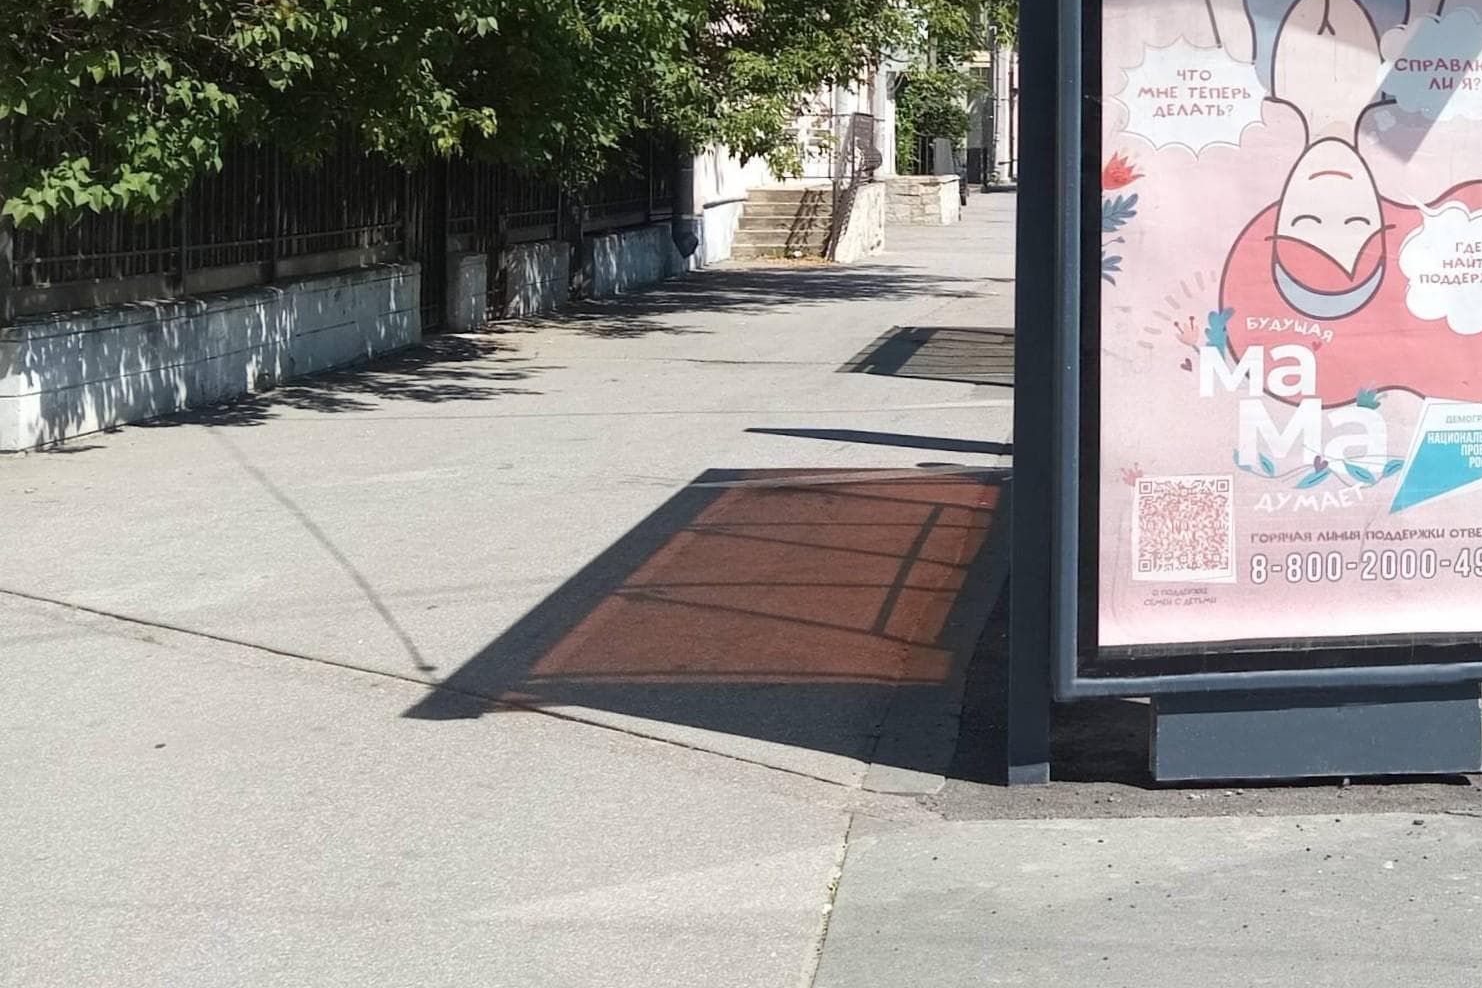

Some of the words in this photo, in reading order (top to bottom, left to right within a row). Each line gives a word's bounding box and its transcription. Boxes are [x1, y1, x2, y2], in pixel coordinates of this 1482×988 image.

[1177, 69, 1212, 81] ЧТО
[1428, 77, 1453, 90] ЛИ
[1462, 77, 1481, 90] Я?
[1137, 86, 1178, 98] МНЕ
[1188, 86, 1251, 99] ТЕПЕРЬ
[1152, 103, 1234, 118] ДЕЛАТЬ?
[1456, 242, 1482, 254] ГДЕ
[1246, 317, 1333, 342] БУДУЩАЯ
[1254, 484, 1365, 512] ДУМАЕТ
[1250, 531, 1312, 543] ГОРЯЧАЯ
[1317, 530, 1360, 542] ЛИНИЯ
[1366, 528, 1445, 541] ПОДДЕРЖКИ
